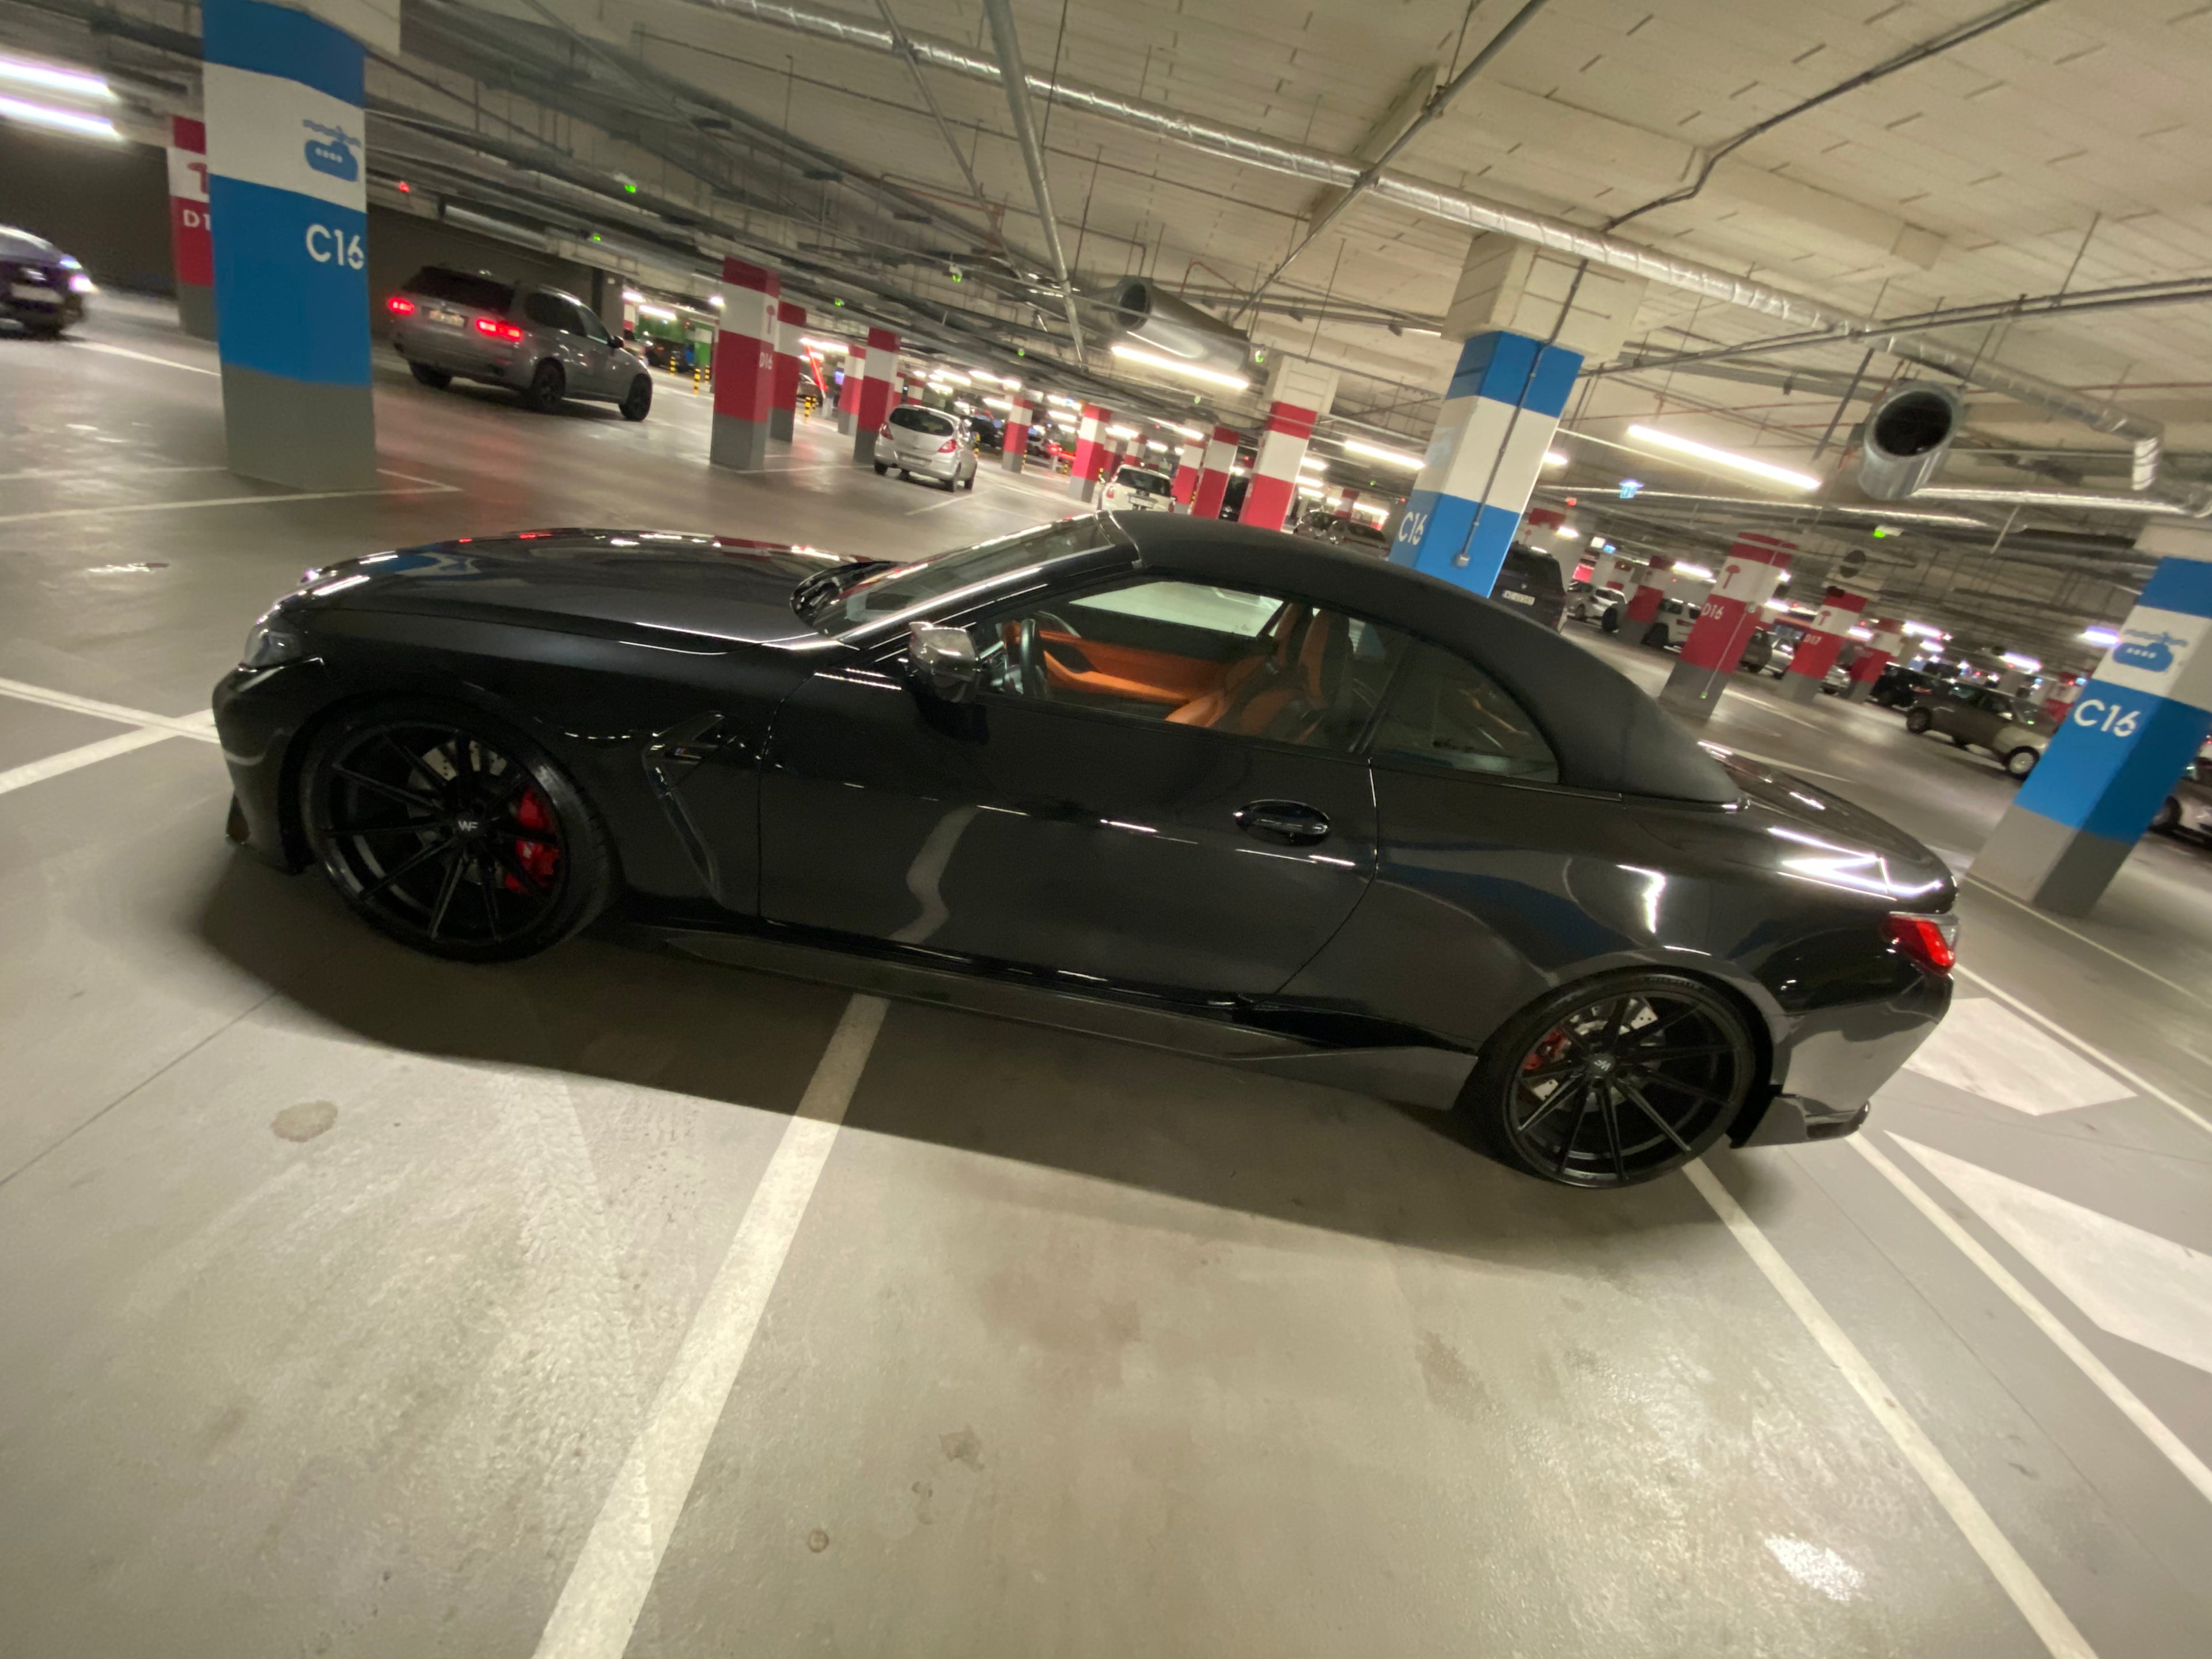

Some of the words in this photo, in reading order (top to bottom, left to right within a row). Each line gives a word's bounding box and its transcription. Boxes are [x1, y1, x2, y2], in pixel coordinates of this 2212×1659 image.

[306, 224, 364, 270] C16
[759, 352, 773, 370] D16
[1399, 512, 1428, 546] C16
[1701, 603, 1725, 620] D16
[2074, 699, 2141, 737] C16
[458, 820, 478, 832] WF
